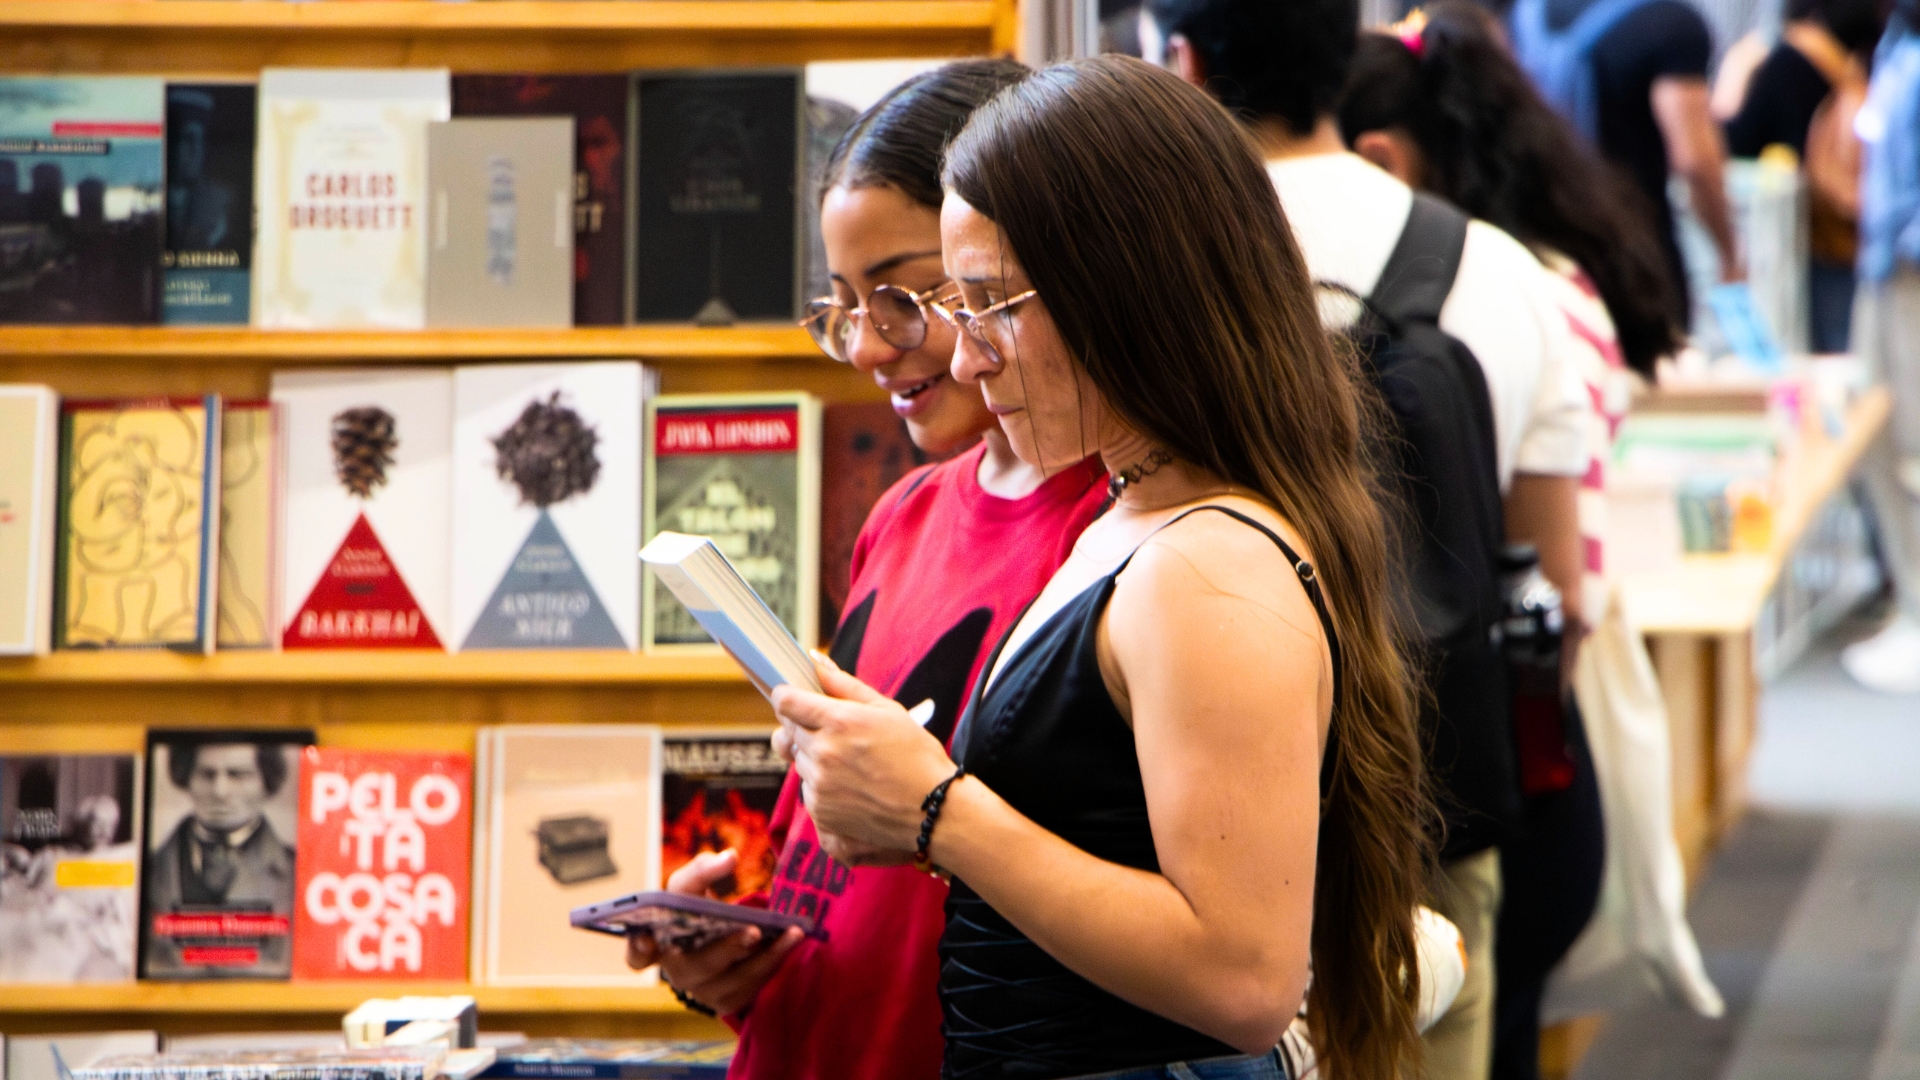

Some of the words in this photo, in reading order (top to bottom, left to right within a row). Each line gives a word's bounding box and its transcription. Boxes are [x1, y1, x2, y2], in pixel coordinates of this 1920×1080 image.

[305, 172, 396, 197] CARLOS
[311, 772, 461, 826] PELO
[344, 816, 427, 872] TA
[305, 871, 456, 928] COSA
[345, 921, 423, 973] CA
